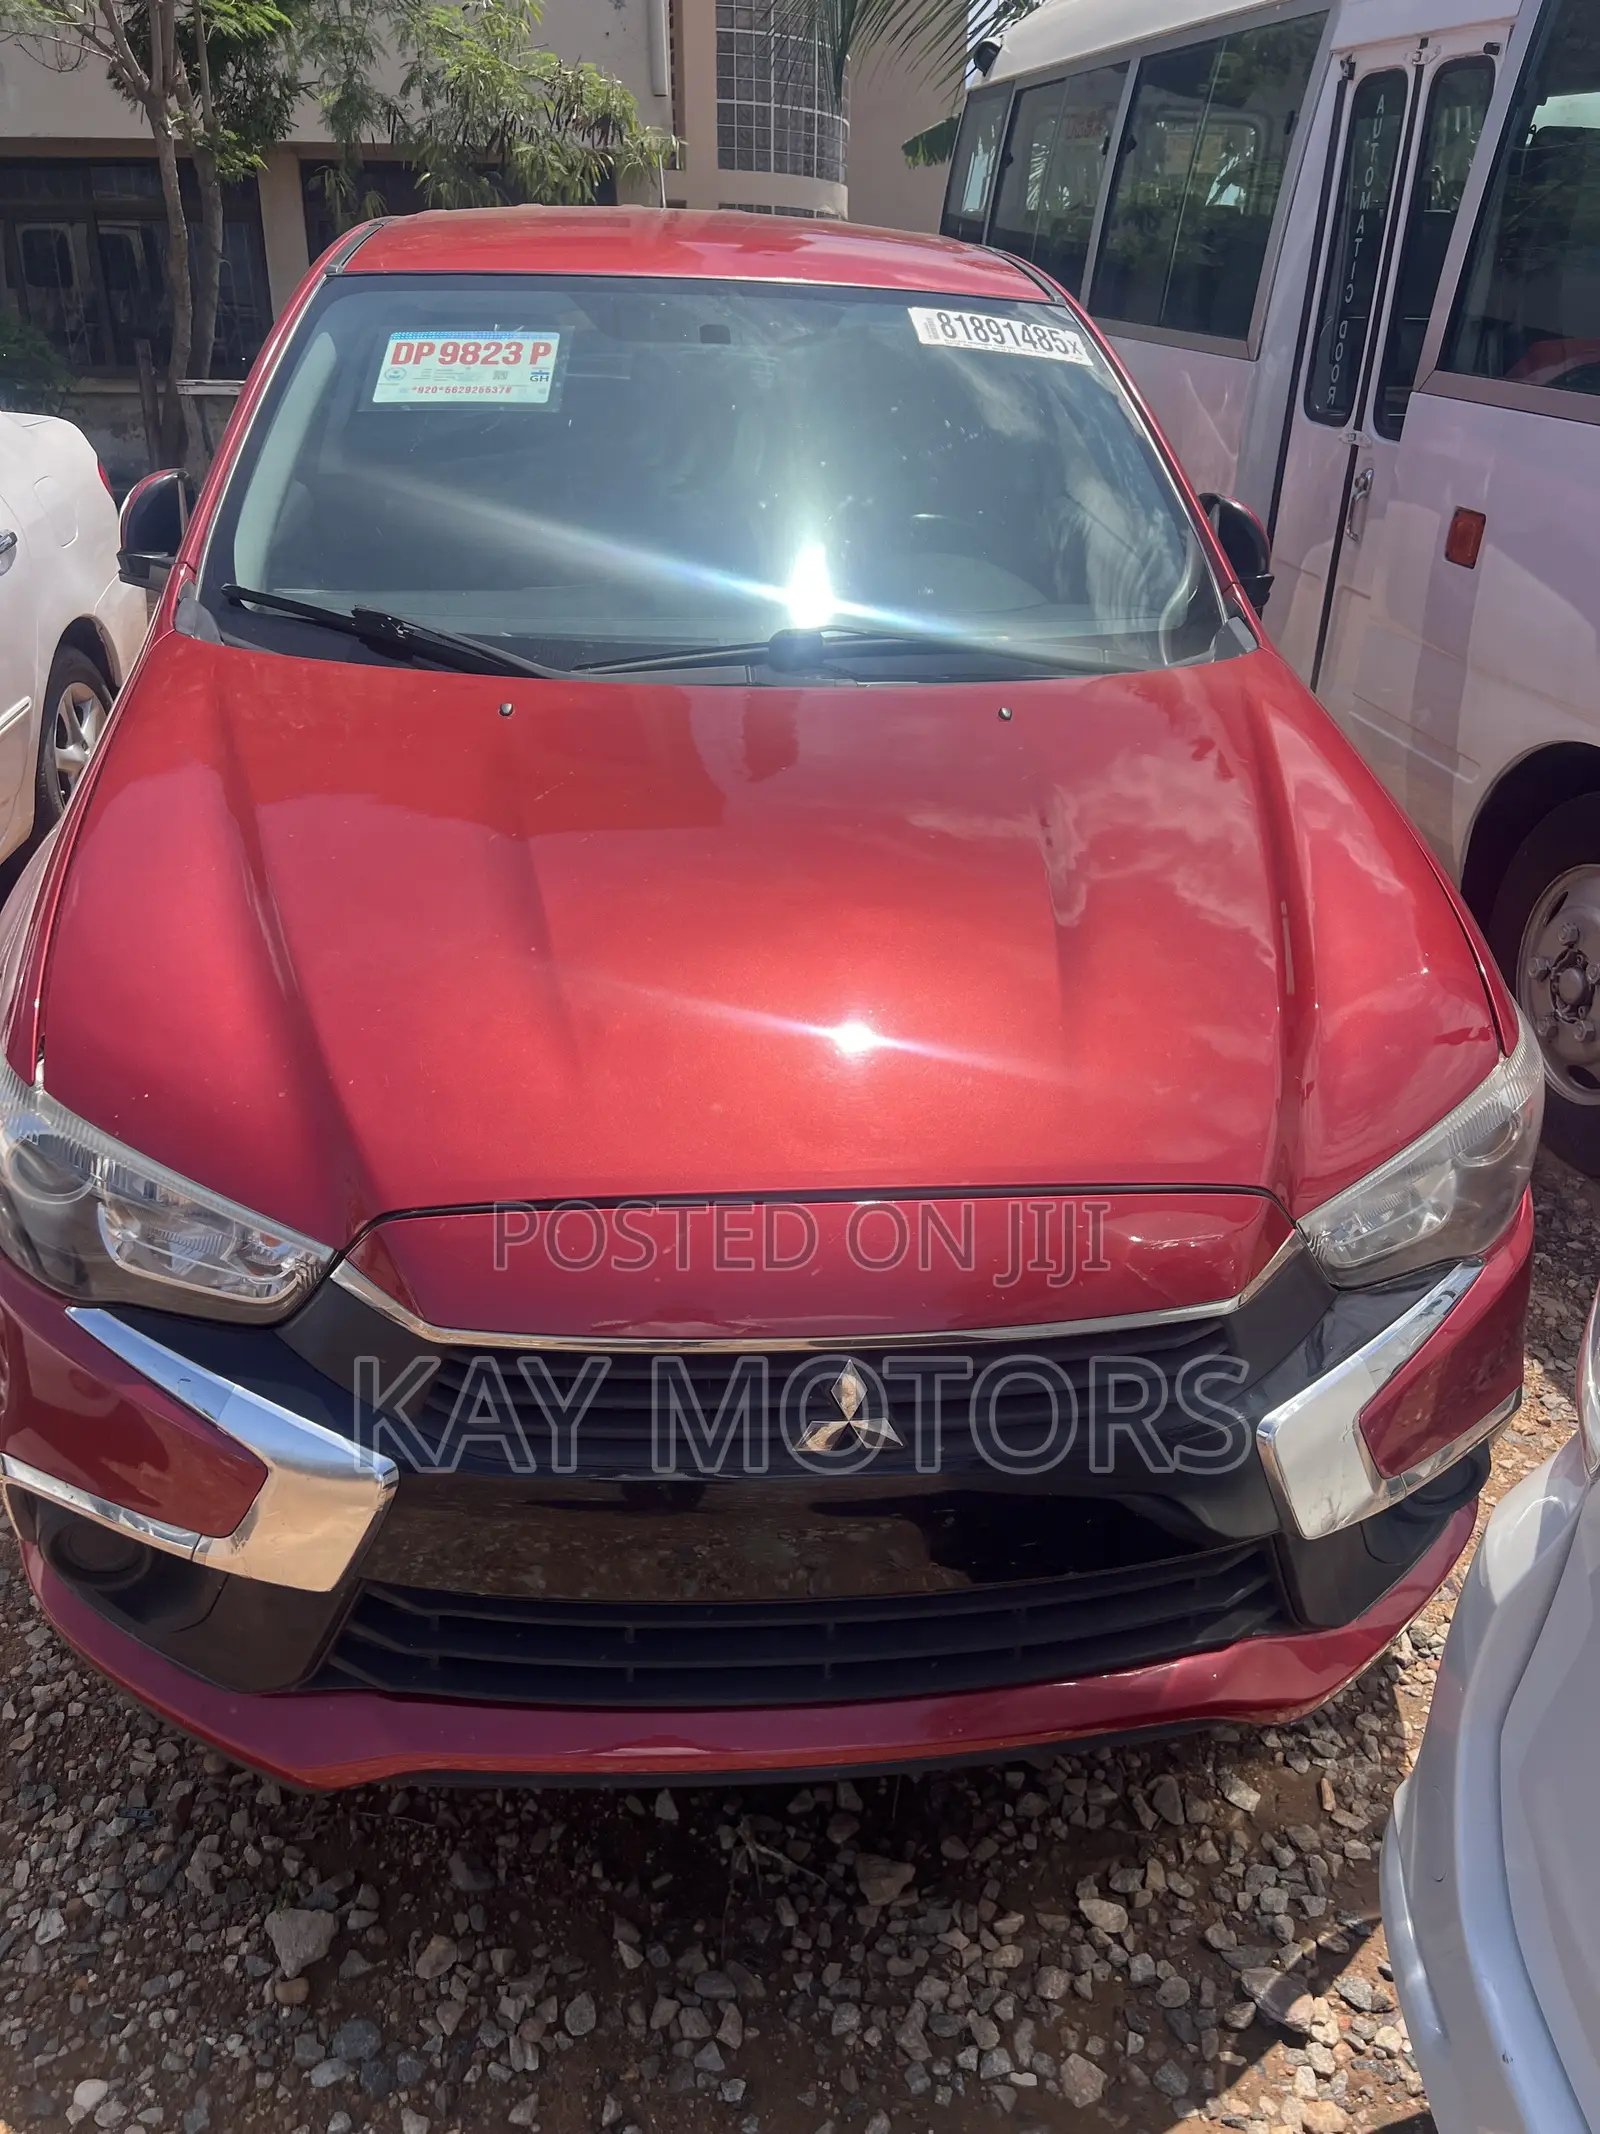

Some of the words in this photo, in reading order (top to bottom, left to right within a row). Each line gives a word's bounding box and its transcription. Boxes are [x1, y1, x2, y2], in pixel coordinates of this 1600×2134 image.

[391, 341, 436, 365] DP
[438, 341, 524, 365] 9823
[529, 342, 552, 365] P
